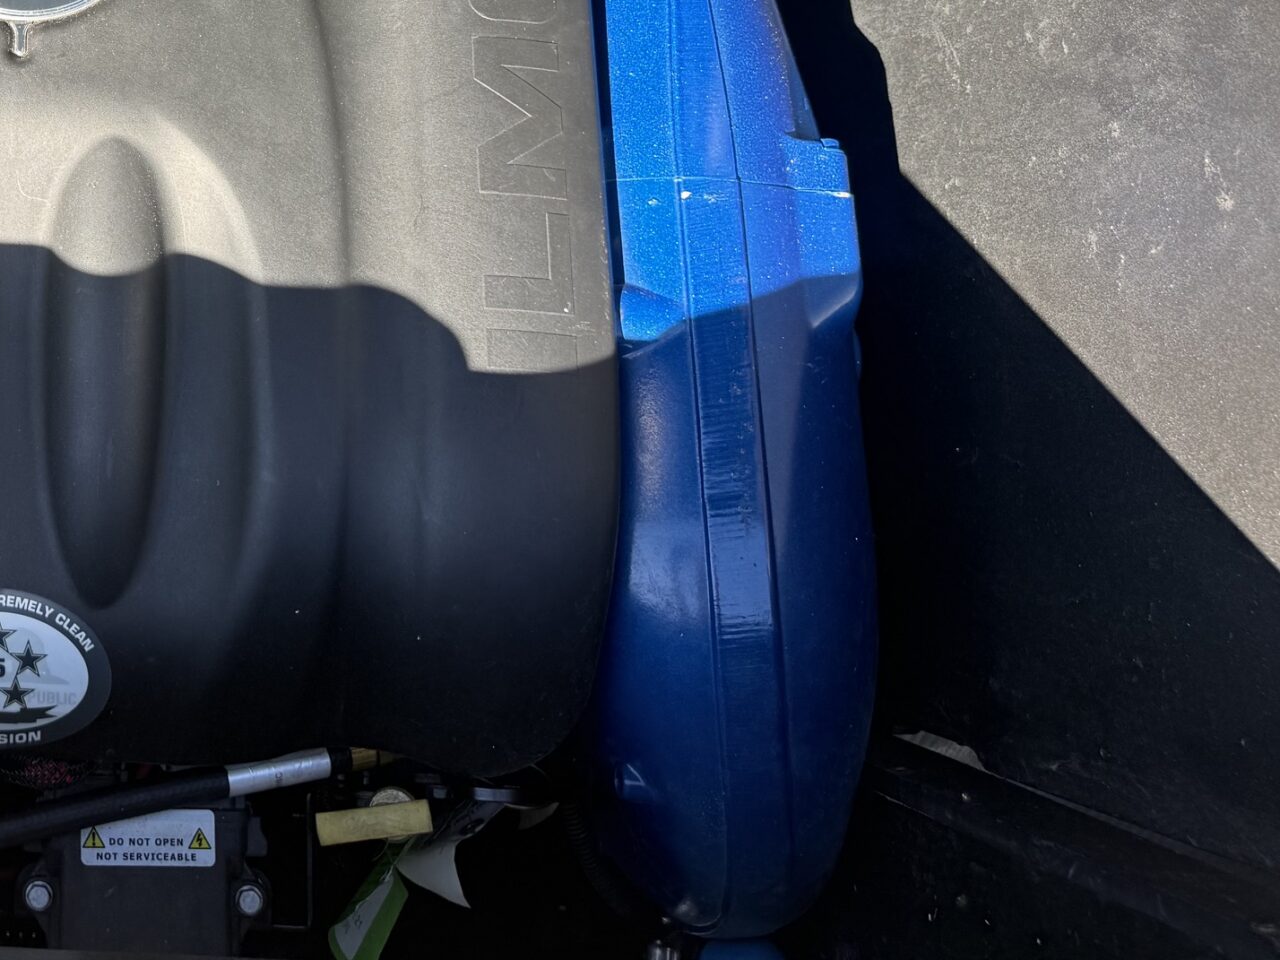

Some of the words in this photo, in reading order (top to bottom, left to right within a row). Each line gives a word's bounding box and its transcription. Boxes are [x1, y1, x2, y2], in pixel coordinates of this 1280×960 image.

[54, 613, 95, 652] CLEAN
[108, 837, 125, 847] DO
[128, 837, 151, 847] NOT
[157, 837, 184, 848] OPEN
[96, 852, 118, 861] NOT
[122, 852, 198, 862] SERVICEABLE
